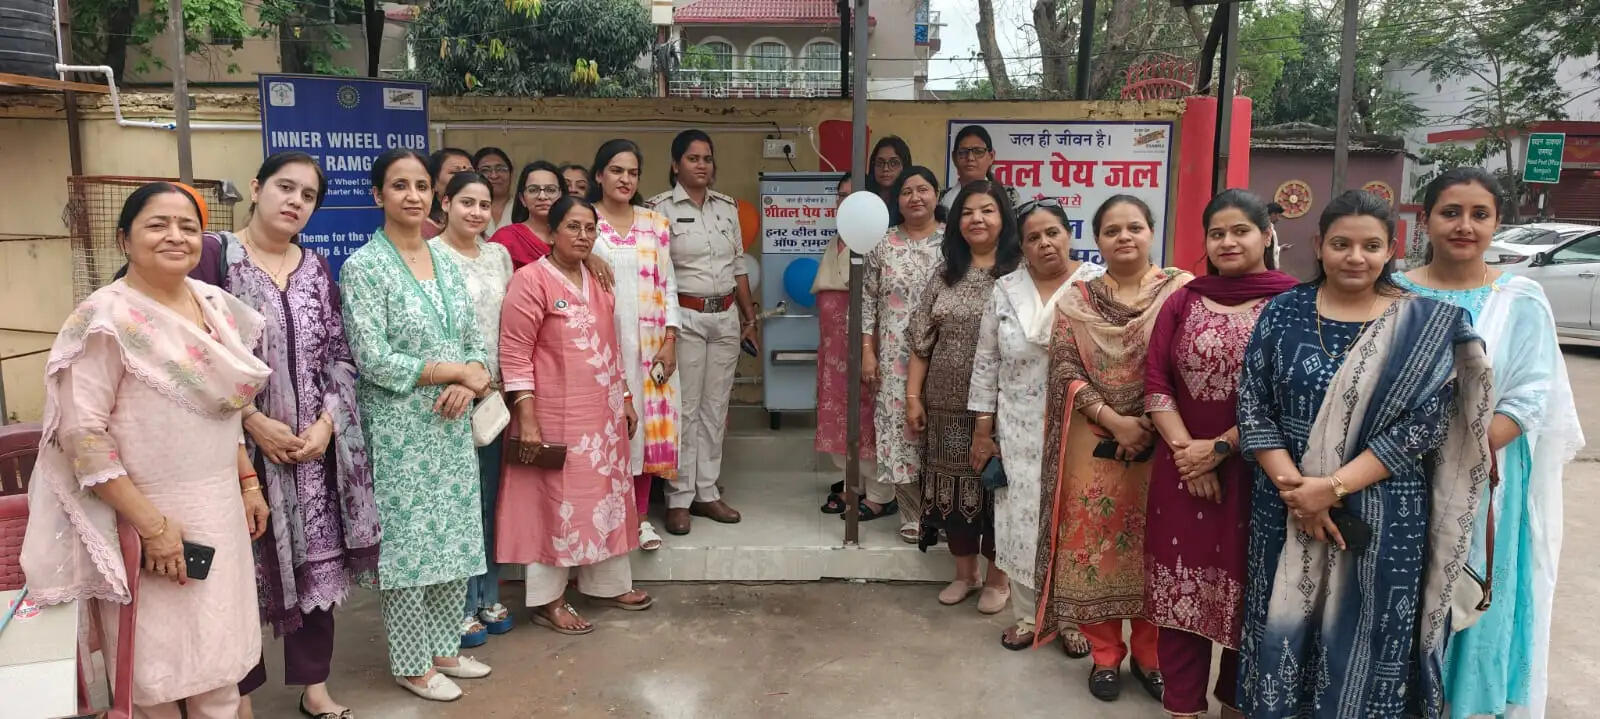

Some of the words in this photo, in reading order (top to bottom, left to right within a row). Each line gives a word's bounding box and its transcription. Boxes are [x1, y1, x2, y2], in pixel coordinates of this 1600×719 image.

[272, 131, 322, 148] INNER
[327, 132, 382, 149] WHEEL
[387, 133, 426, 150] CLUB
[1009, 133, 1035, 146] जल
[1038, 129, 1052, 146] ही
[1055, 129, 1094, 146] जीवन
[326, 155, 378, 171] RAMG
[992, 160, 1044, 188] तल
[1050, 152, 1098, 188] पेय
[1102, 160, 1163, 188] जल
[335, 178, 360, 186] Wheel
[326, 188, 350, 196] harter
[353, 188, 365, 196] No.
[764, 205, 800, 218] शीतल
[803, 205, 821, 218] पेय
[824, 207, 838, 218] ज
[298, 232, 330, 243] Theme
[332, 232, 346, 242] for
[348, 231, 364, 241] the
[333, 246, 341, 256] &
